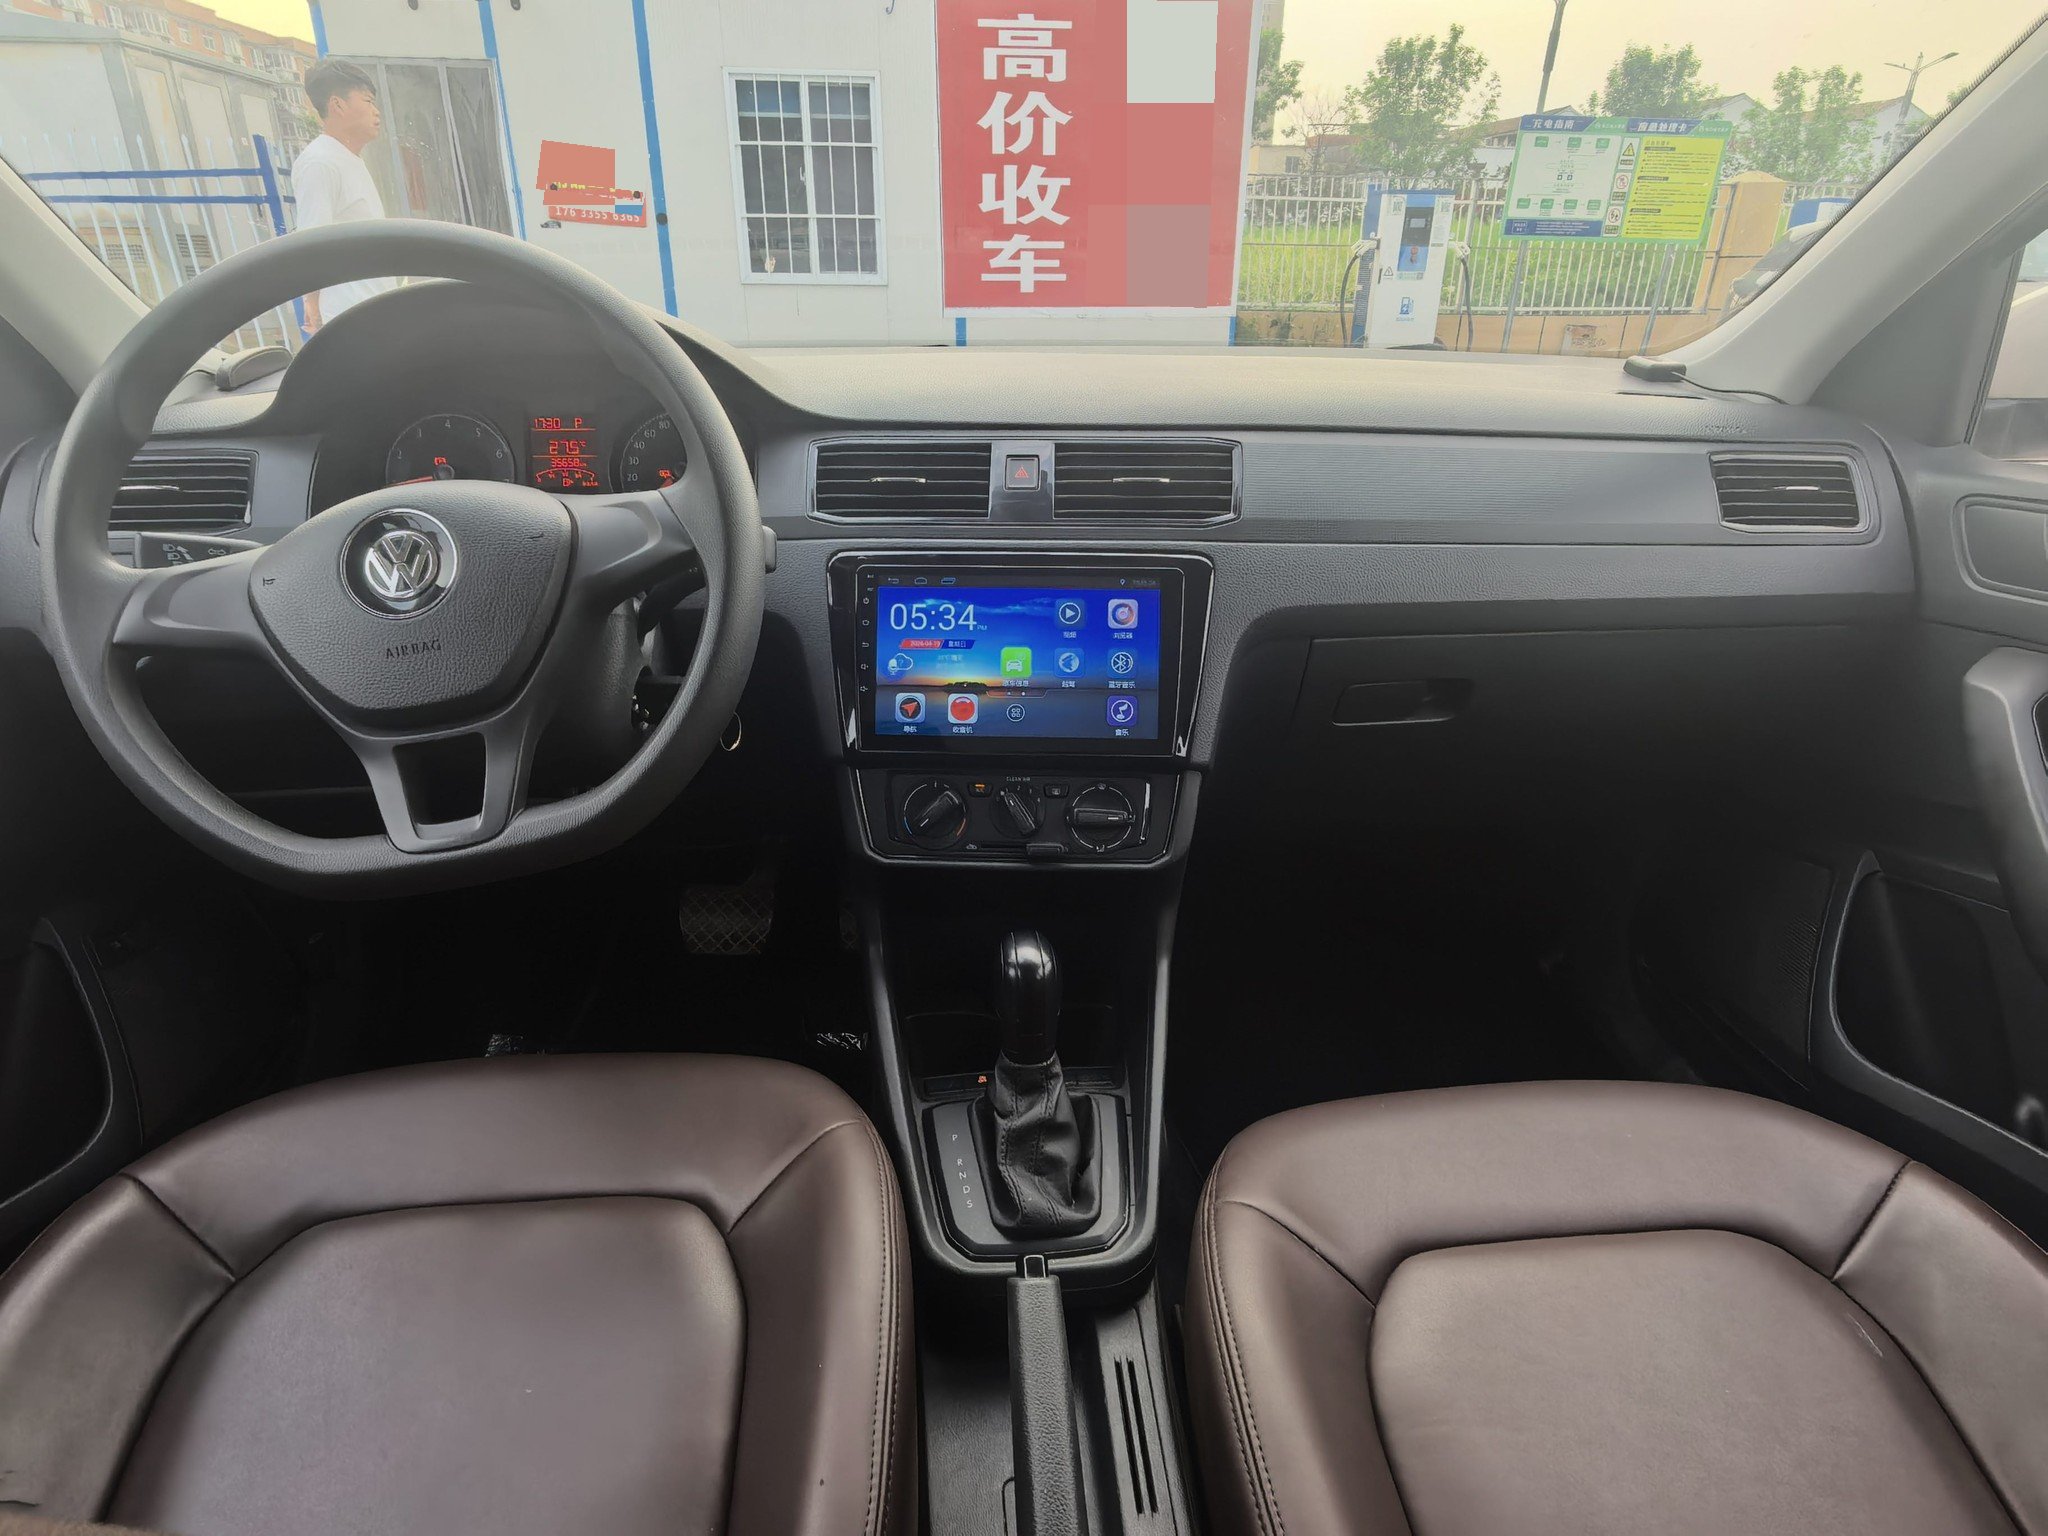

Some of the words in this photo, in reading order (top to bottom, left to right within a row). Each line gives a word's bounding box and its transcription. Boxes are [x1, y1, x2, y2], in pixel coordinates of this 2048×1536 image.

[976, 13, 1074, 293] 高价收车
[555, 206, 576, 217] 176
[581, 210, 608, 220] 3355
[890, 603, 977, 631] 05:34
[385, 638, 442, 660] AIRBAG
[957, 1158, 963, 1167] R
[958, 1171, 967, 1180] N
[962, 1185, 970, 1194] D
[966, 1200, 973, 1208] S
